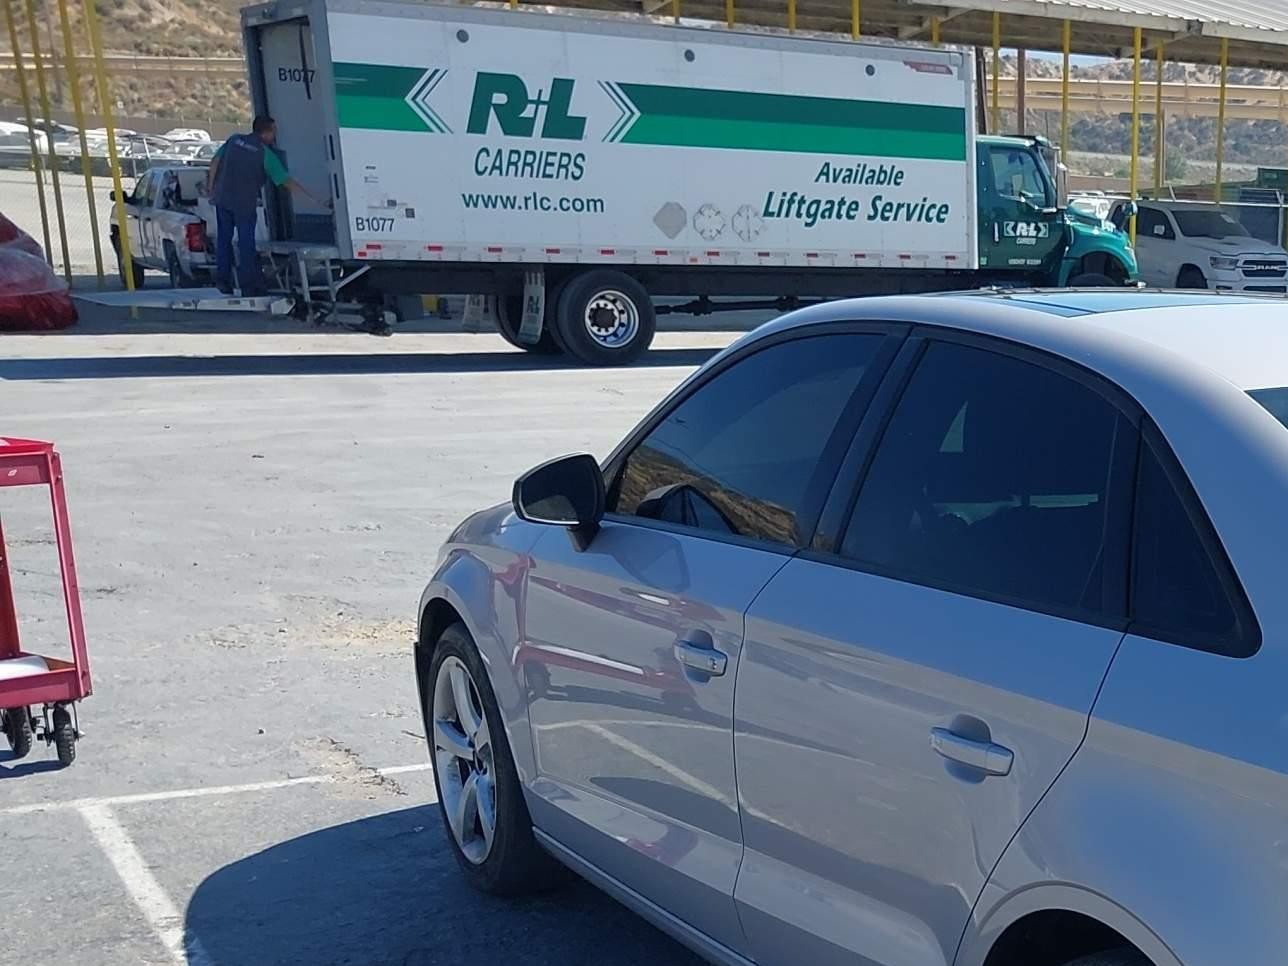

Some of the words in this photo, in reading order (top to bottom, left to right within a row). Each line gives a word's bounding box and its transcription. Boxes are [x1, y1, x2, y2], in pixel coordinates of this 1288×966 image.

[466, 71, 588, 141] R+L
[474, 147, 586, 181] CARRIERS
[814, 162, 904, 186] Available
[461, 192, 604, 213] www.rlc.com
[762, 191, 859, 227] Liftgate
[867, 195, 949, 223] Service
[355, 217, 395, 233] B1077
